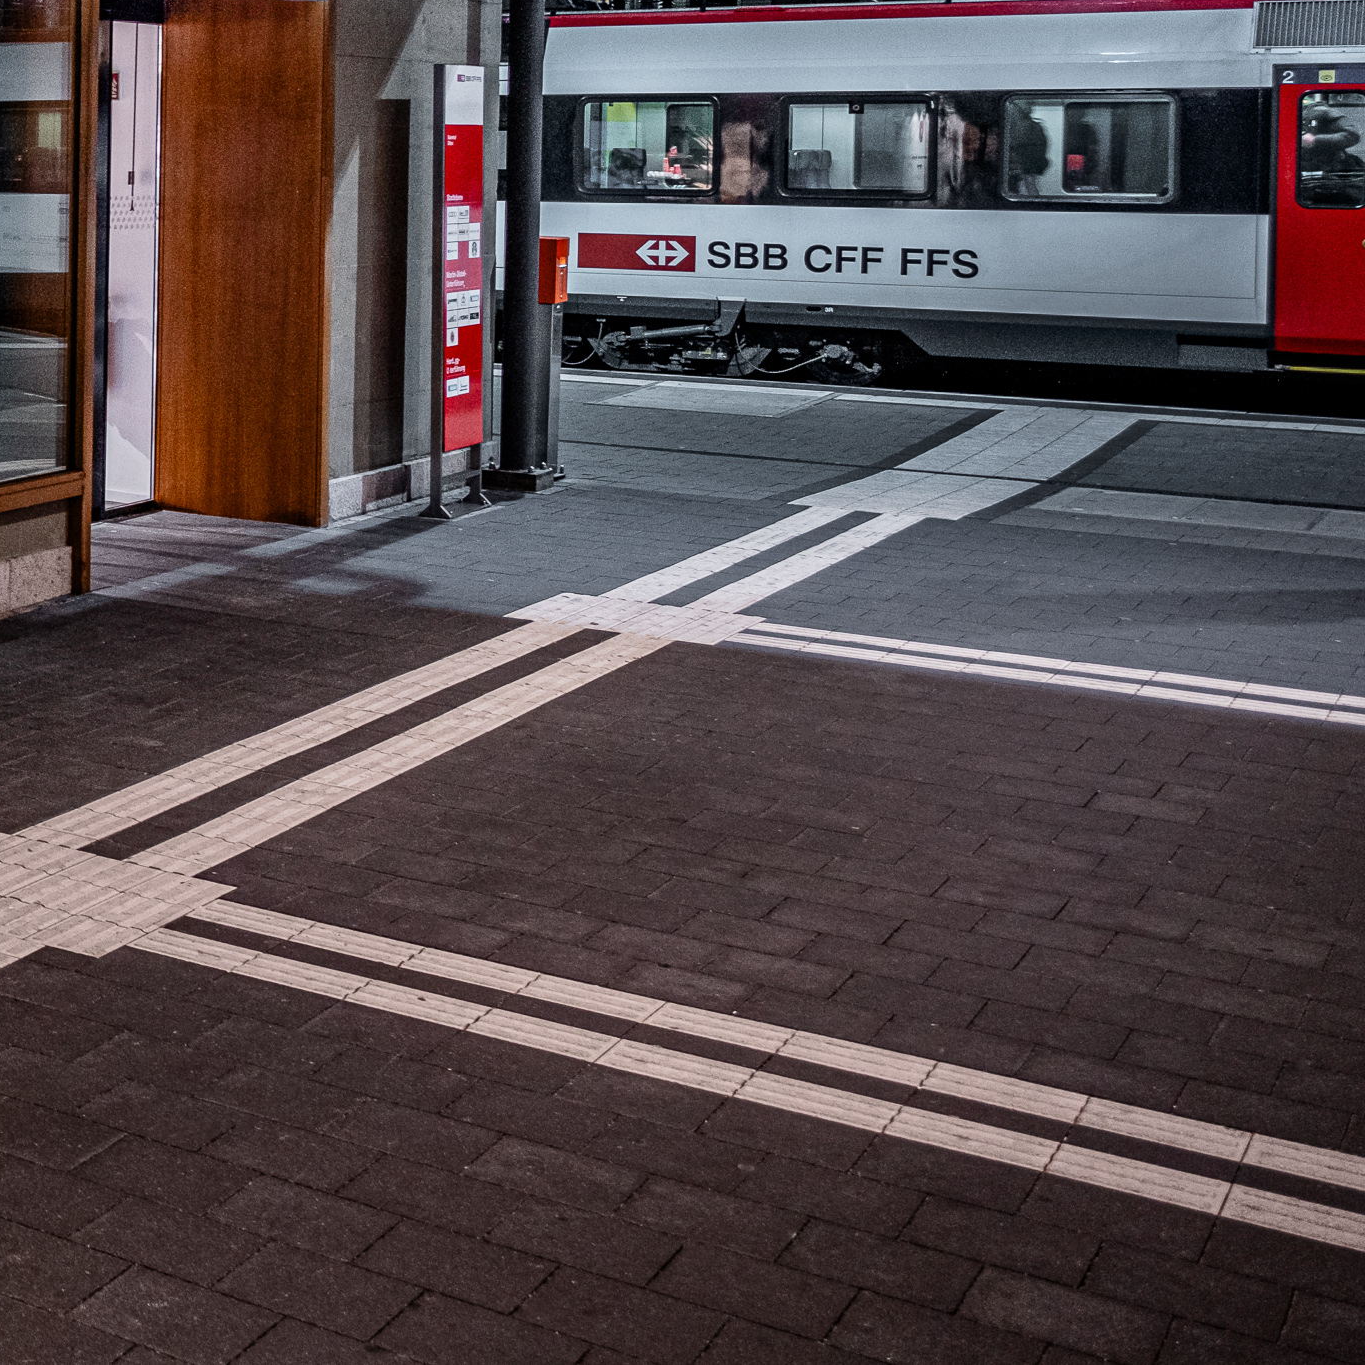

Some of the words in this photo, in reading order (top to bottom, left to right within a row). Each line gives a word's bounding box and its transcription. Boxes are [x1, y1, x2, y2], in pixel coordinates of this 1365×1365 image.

[1282, 71, 1294, 84] 2
[707, 241, 788, 270] SBB
[804, 244, 884, 274] CFF
[900, 247, 979, 279] FFS
